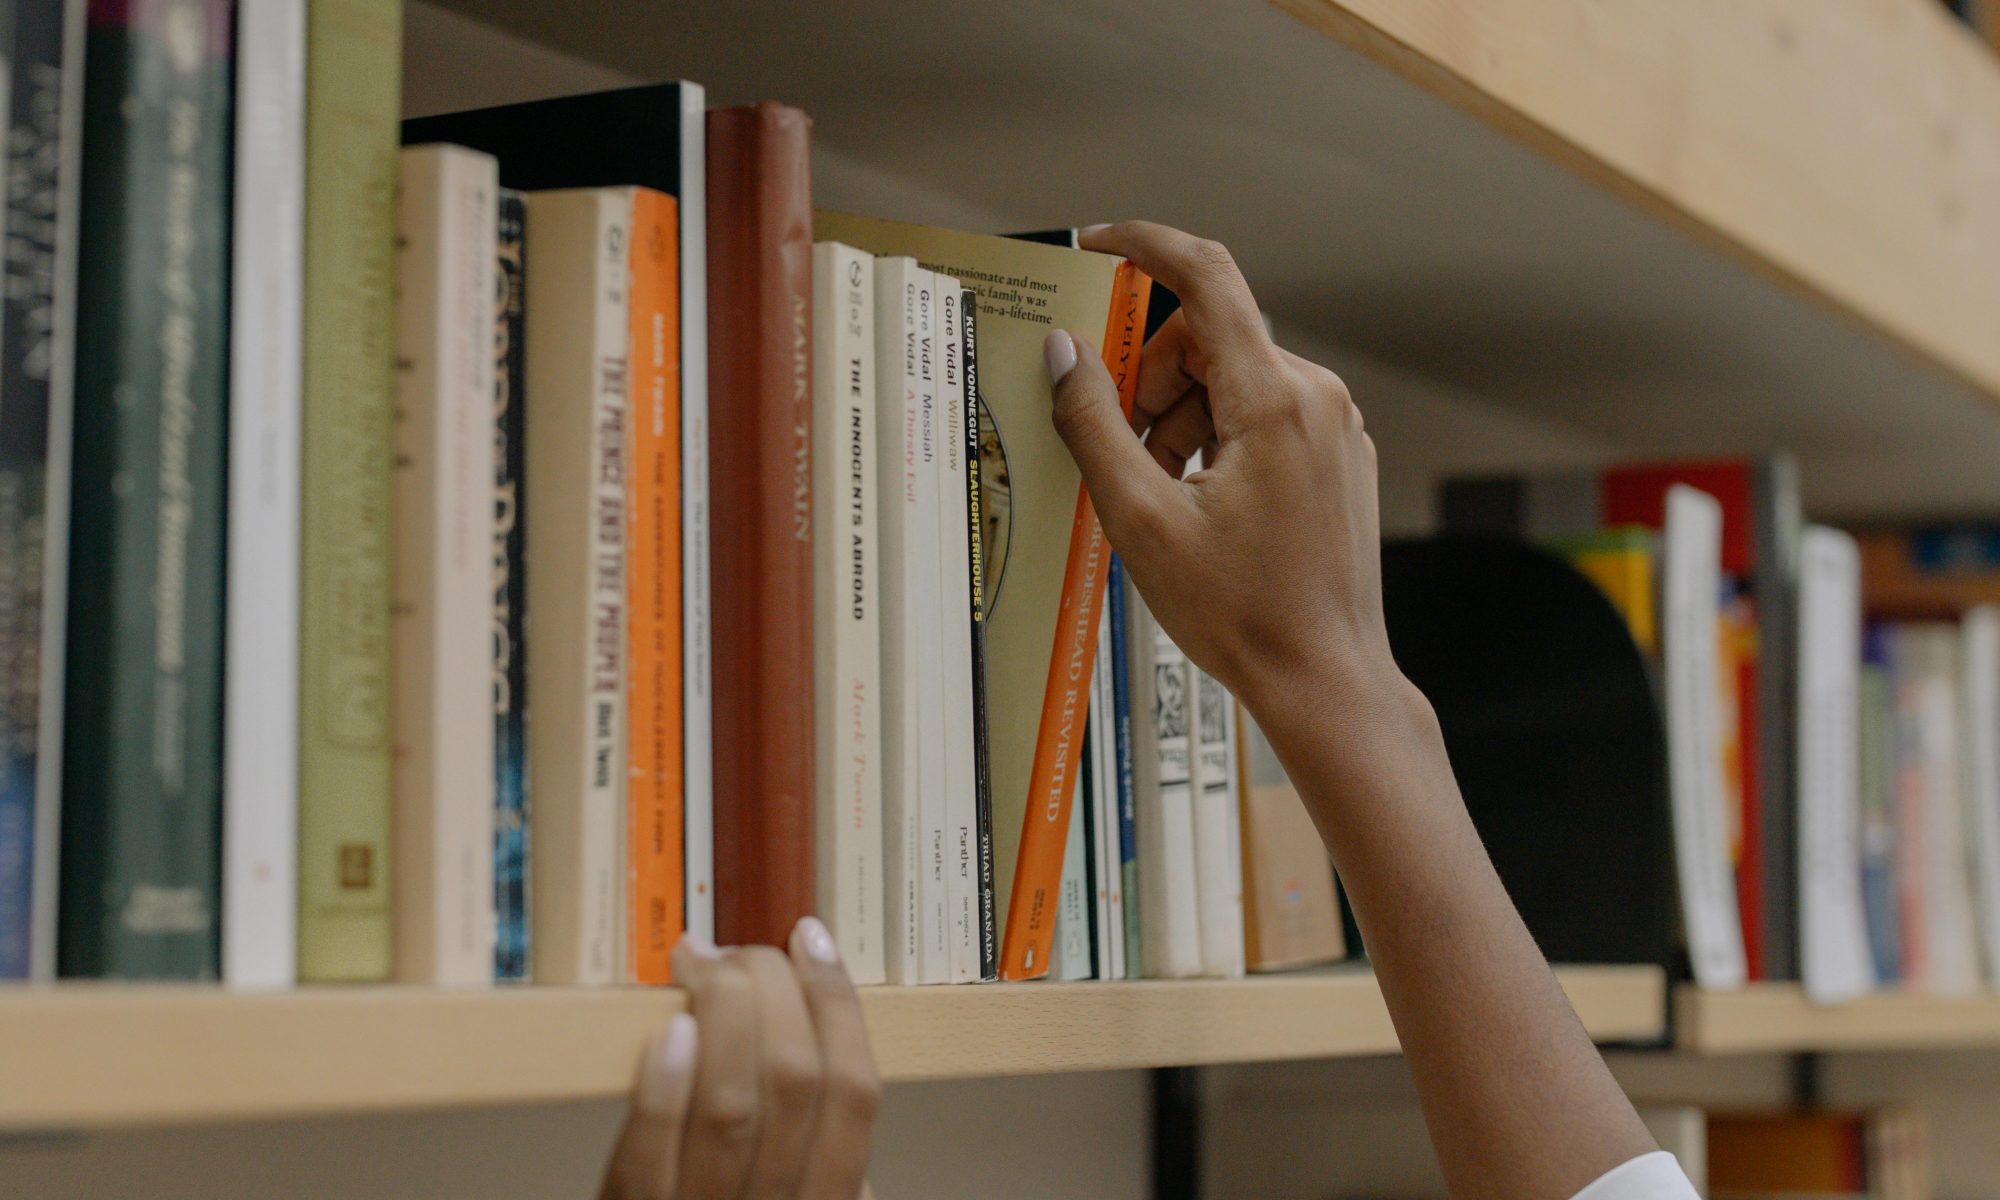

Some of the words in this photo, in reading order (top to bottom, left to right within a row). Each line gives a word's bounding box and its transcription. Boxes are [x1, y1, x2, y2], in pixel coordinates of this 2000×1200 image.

[906, 283, 915, 325] Gore
[947, 266, 1005, 284] passionate
[1006, 276, 1028, 288] and
[1030, 280, 1058, 293] most
[988, 286, 1024, 306] family
[1026, 296, 1047, 308] was
[920, 289, 930, 331] Gore
[945, 295, 955, 336] Gore
[975, 301, 1053, 325] -in-a-lifetime
[652, 311, 665, 367] MARK
[793, 294, 808, 400] MARK
[906, 332, 915, 377] Vidal
[921, 337, 931, 381] Vidal
[945, 343, 957, 386] Vidal
[965, 315, 975, 360] KURT
[1117, 292, 1138, 393] EVELYN
[851, 358, 861, 398] THE
[652, 375, 665, 436] TWAIN
[922, 393, 934, 462] Messiah
[967, 364, 978, 450] VONNEGUT
[906, 409, 915, 466] Thirsty
[948, 399, 958, 471] Williwaw
[794, 424, 809, 542] TWAIN
[851, 407, 863, 526] INNOCENTS
[906, 472, 915, 502] Evil
[969, 459, 982, 606] SLAUGHTERHOUSE
[852, 534, 864, 620] ABROAD
[974, 611, 983, 622] 5
[852, 677, 866, 744] Mark
[1046, 687, 1078, 824] REVISITED
[852, 754, 867, 832] Twain
[934, 829, 943, 881] Panther
[960, 826, 968, 878] Panther
[982, 833, 990, 883] TRIAD
[984, 888, 993, 964] GRANADA
